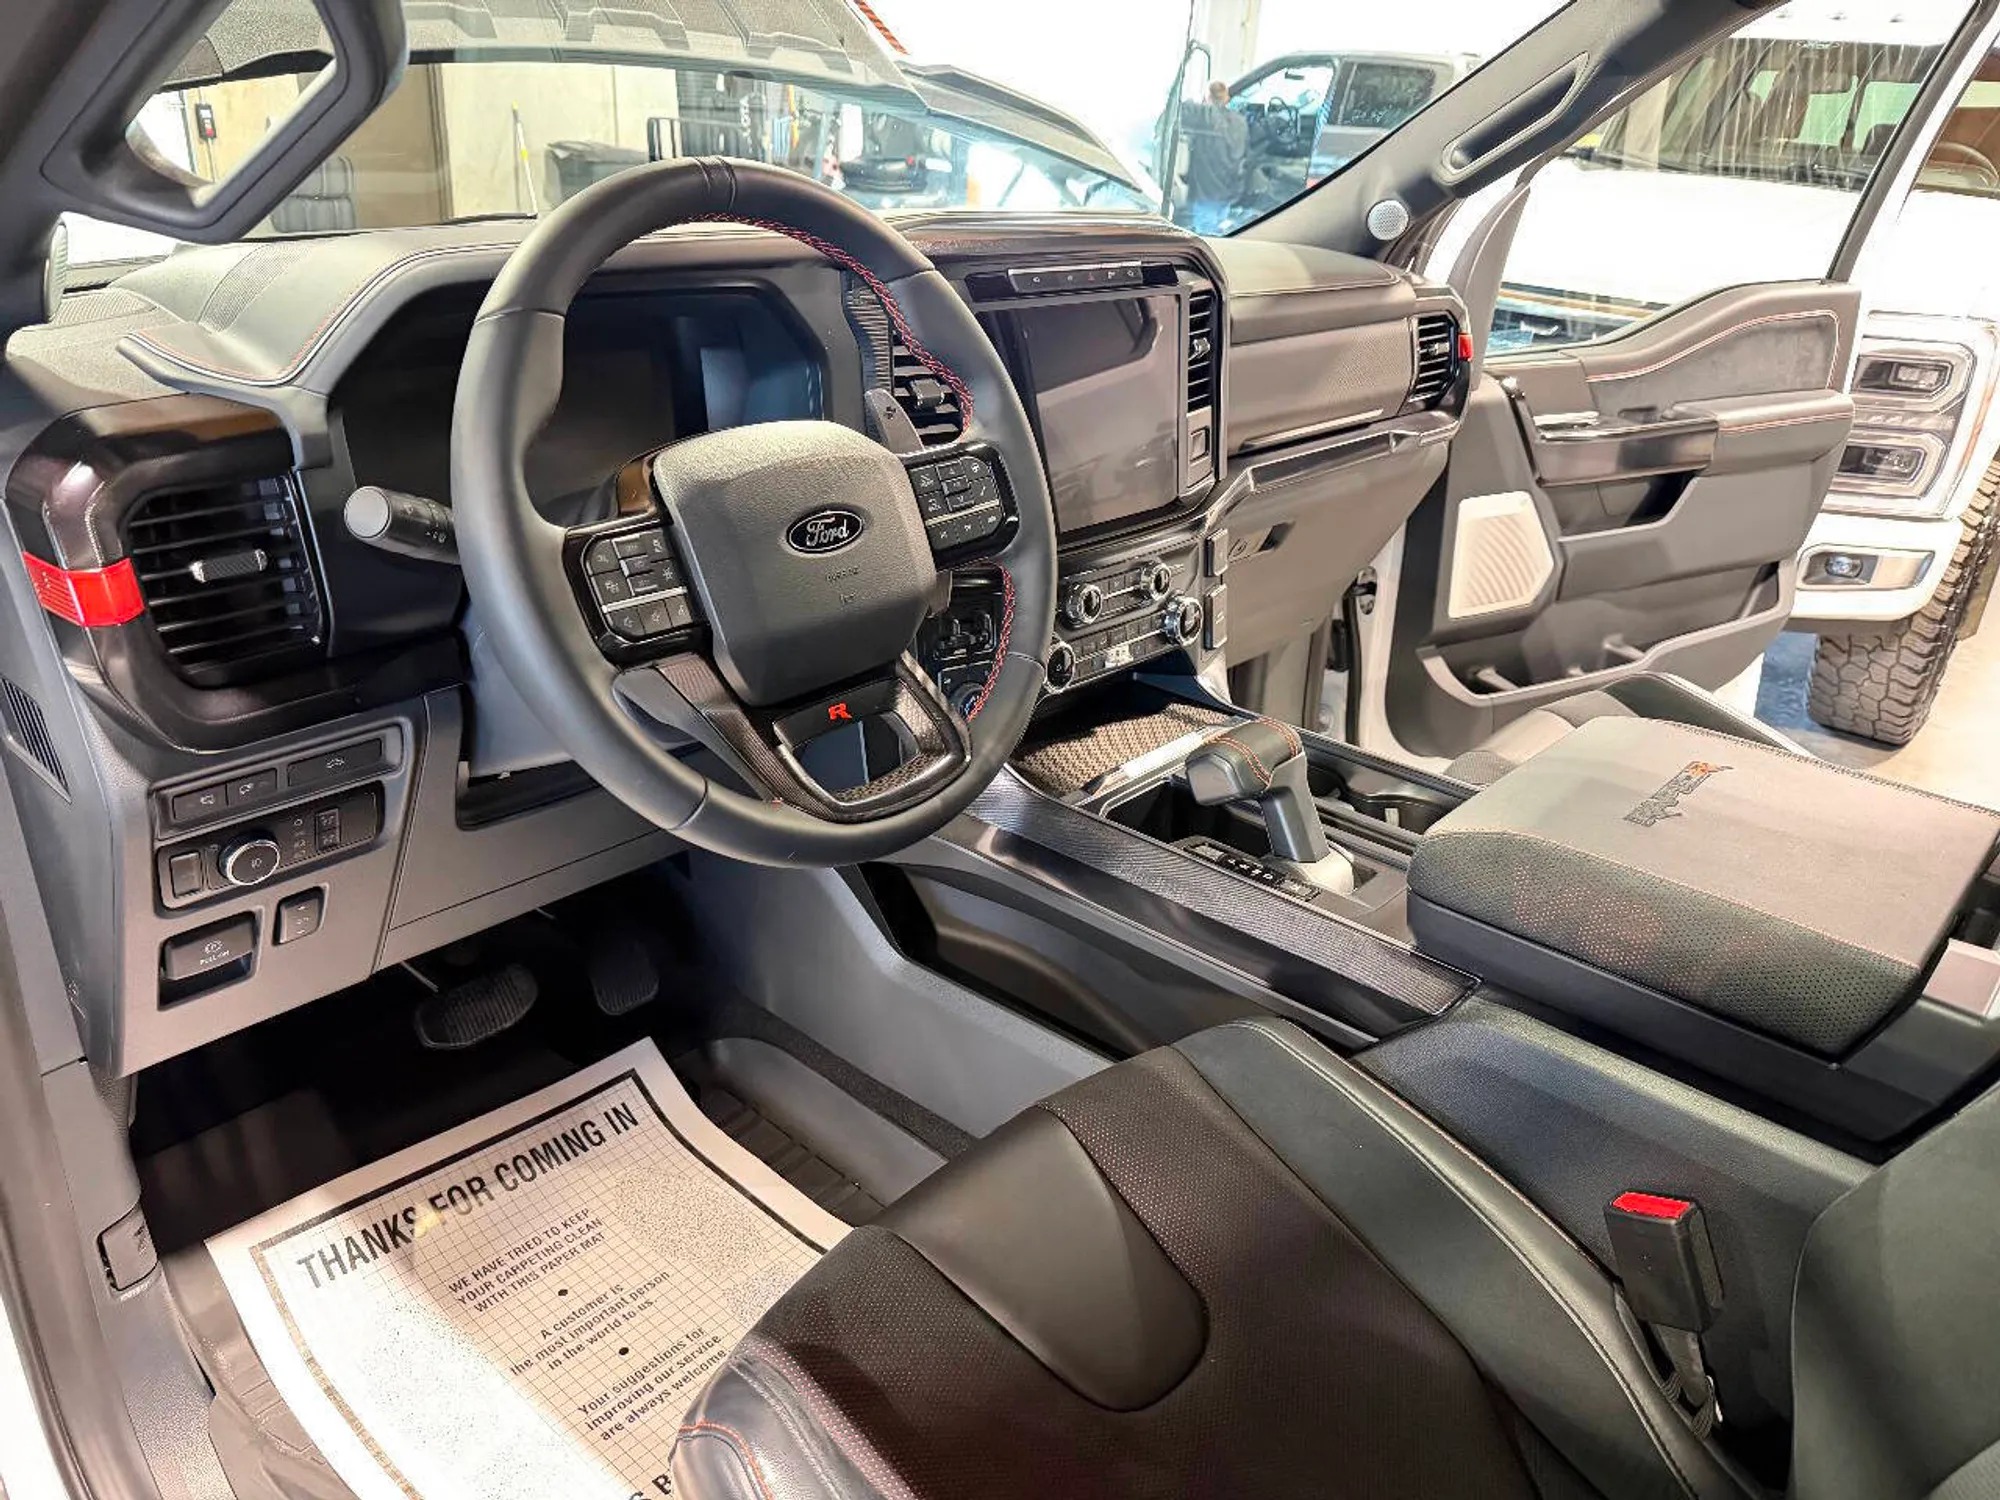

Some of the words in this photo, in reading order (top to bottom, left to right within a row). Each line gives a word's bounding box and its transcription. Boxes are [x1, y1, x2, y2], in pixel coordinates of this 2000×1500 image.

[806, 516, 850, 547] Ford
[828, 702, 853, 720] R
[428, 1176, 494, 1225] FOR
[494, 1120, 606, 1192] COMING
[603, 1102, 639, 1135] IN
[449, 1277, 472, 1294] WE
[471, 1256, 506, 1282] HAVE
[505, 1236, 542, 1261] TRIED
[543, 1226, 561, 1239] TO
[561, 1208, 590, 1230] KEEP
[457, 1281, 495, 1305] YOUR
[496, 1240, 564, 1284] CARPETING
[564, 1217, 603, 1244] CLEAN
[474, 1290, 509, 1312] WITH
[510, 1270, 540, 1292] THIS
[540, 1247, 581, 1274] PAPER
[579, 1232, 605, 1250] MAT
[510, 1358, 533, 1376] the
[535, 1335, 568, 1361] most
[568, 1297, 629, 1340] important
[629, 1271, 671, 1301] person
[540, 1329, 552, 1341] A
[553, 1294, 610, 1332] customer
[609, 1284, 624, 1295] is
[547, 1359, 563, 1371] in
[562, 1343, 586, 1359] the
[586, 1318, 622, 1345] world
[621, 1310, 637, 1322] to
[578, 1392, 611, 1416] Your
[612, 1340, 687, 1394] suggestions
[685, 1327, 706, 1344] for
[585, 1382, 655, 1431] improving
[654, 1365, 677, 1385] our
[676, 1335, 722, 1369] service
[600, 1422, 625, 1441] are
[625, 1388, 672, 1424] always
